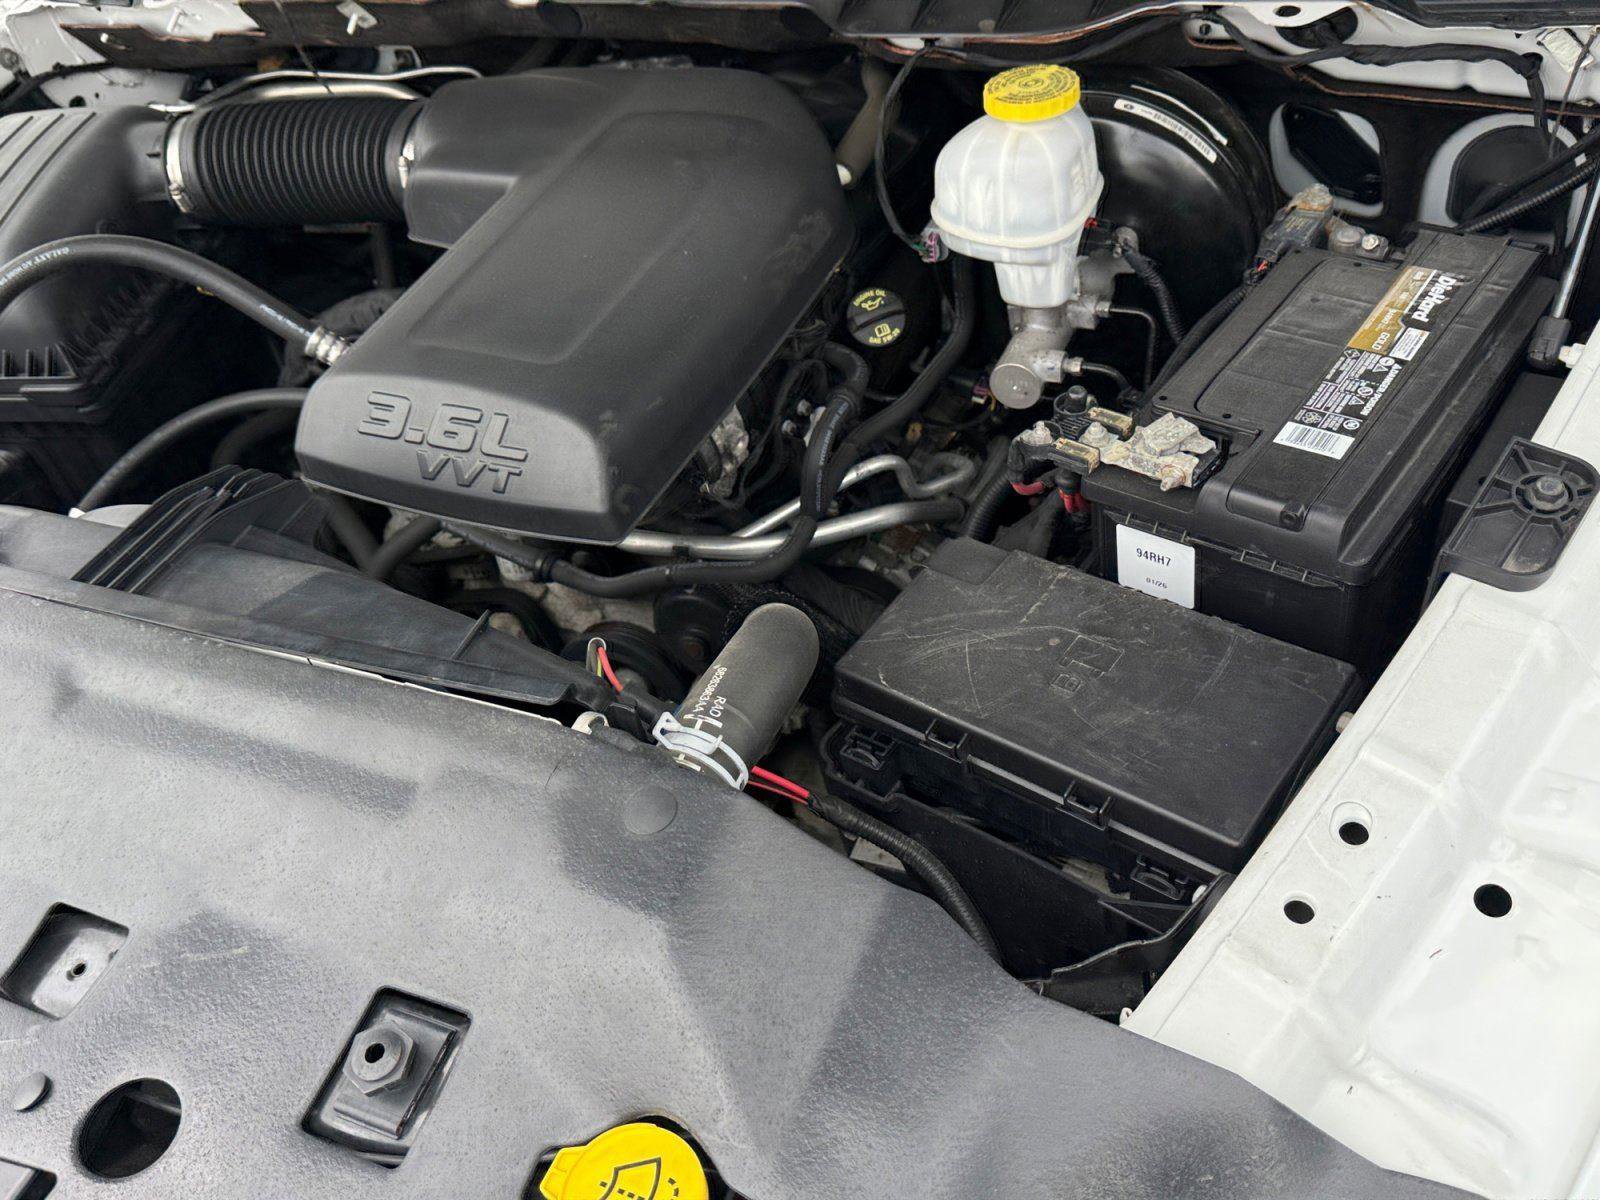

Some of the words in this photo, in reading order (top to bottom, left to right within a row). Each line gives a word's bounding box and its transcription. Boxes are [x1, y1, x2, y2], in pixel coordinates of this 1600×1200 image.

[853, 289, 875, 306] ENGINE
[875, 289, 887, 297] OIL
[1411, 275, 1457, 322] DieHard
[1371, 332, 1390, 350] GOLD
[357, 390, 529, 462] 3.6L
[416, 449, 523, 494] VVT
[1136, 547, 1172, 567] 94RH7
[1145, 577, 1168, 589] 01/26
[709, 695, 727, 718] RAD
